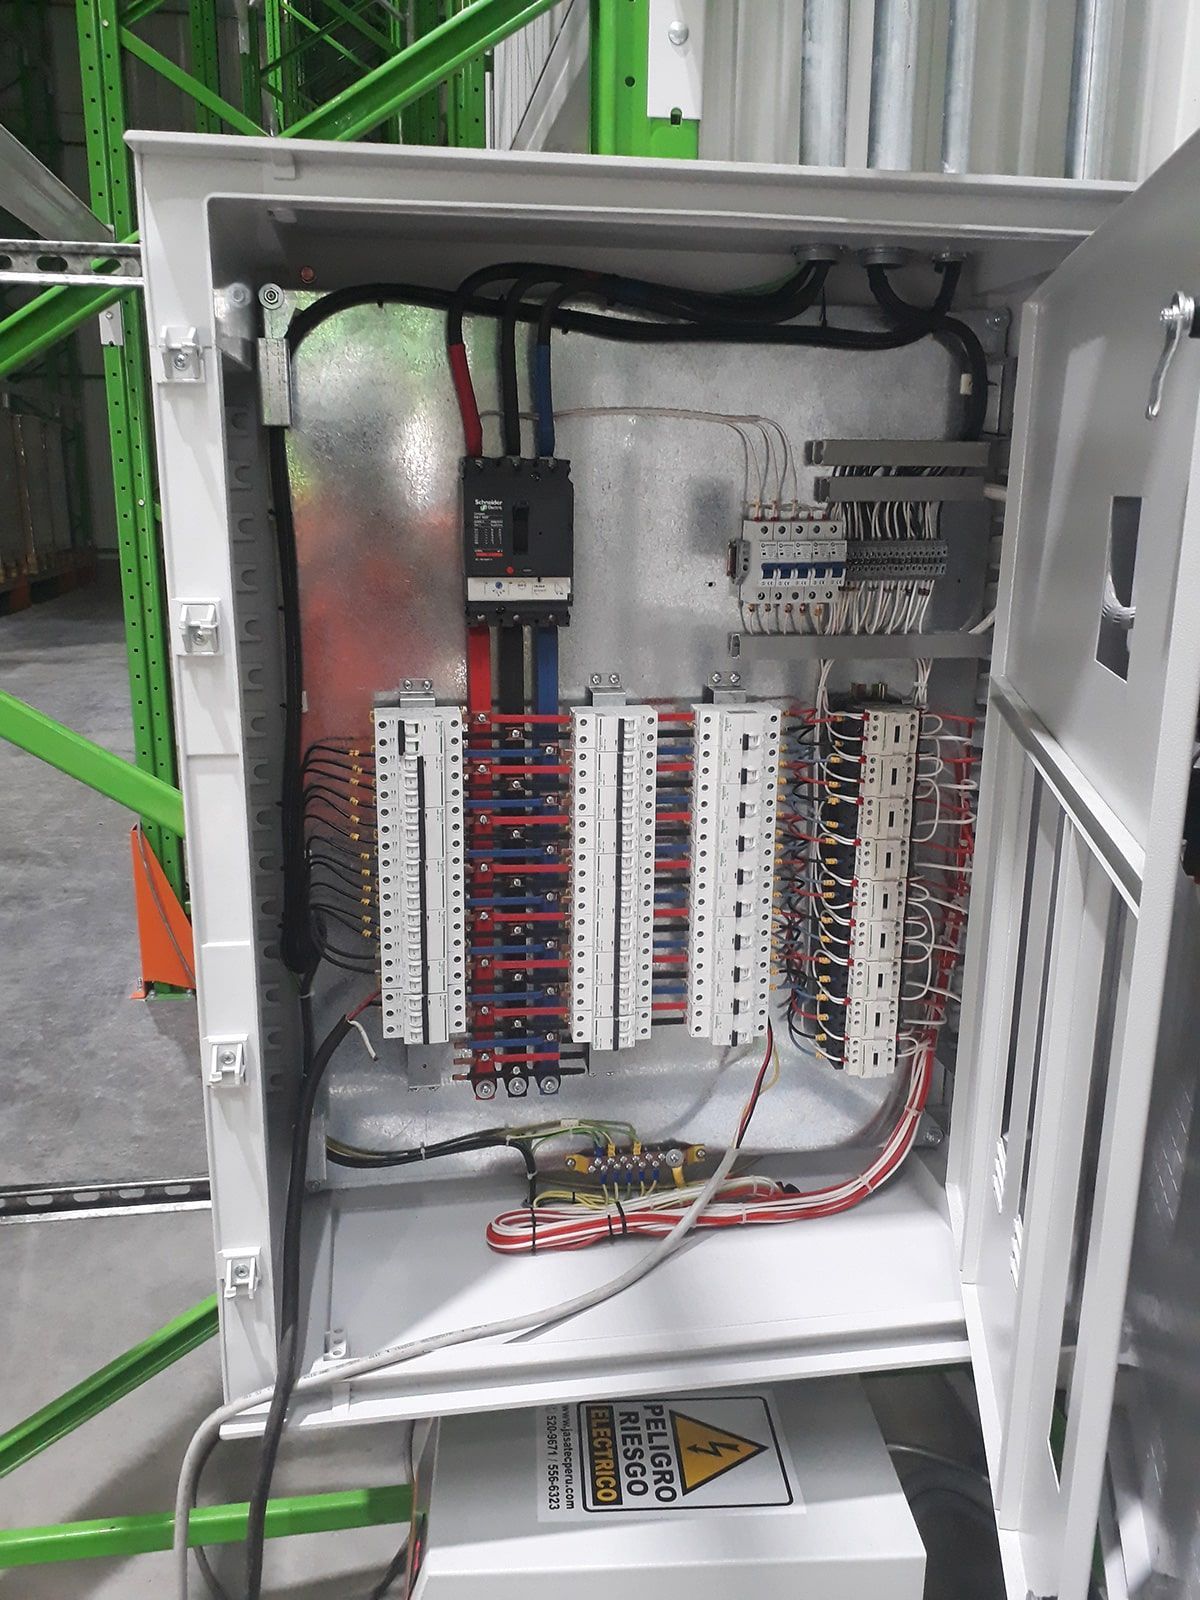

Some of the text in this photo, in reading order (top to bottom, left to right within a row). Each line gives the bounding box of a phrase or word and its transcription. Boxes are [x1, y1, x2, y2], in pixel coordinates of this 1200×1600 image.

[546, 1415, 558, 1456] 520-9671
[560, 1404, 575, 1510] www.jasatecperu.com
[590, 1404, 618, 1503] ELECTRICO
[619, 1411, 649, 1496] RIESGO
[643, 1404, 677, 1502] PELIGRO
[547, 1464, 561, 1510] 556-6323
